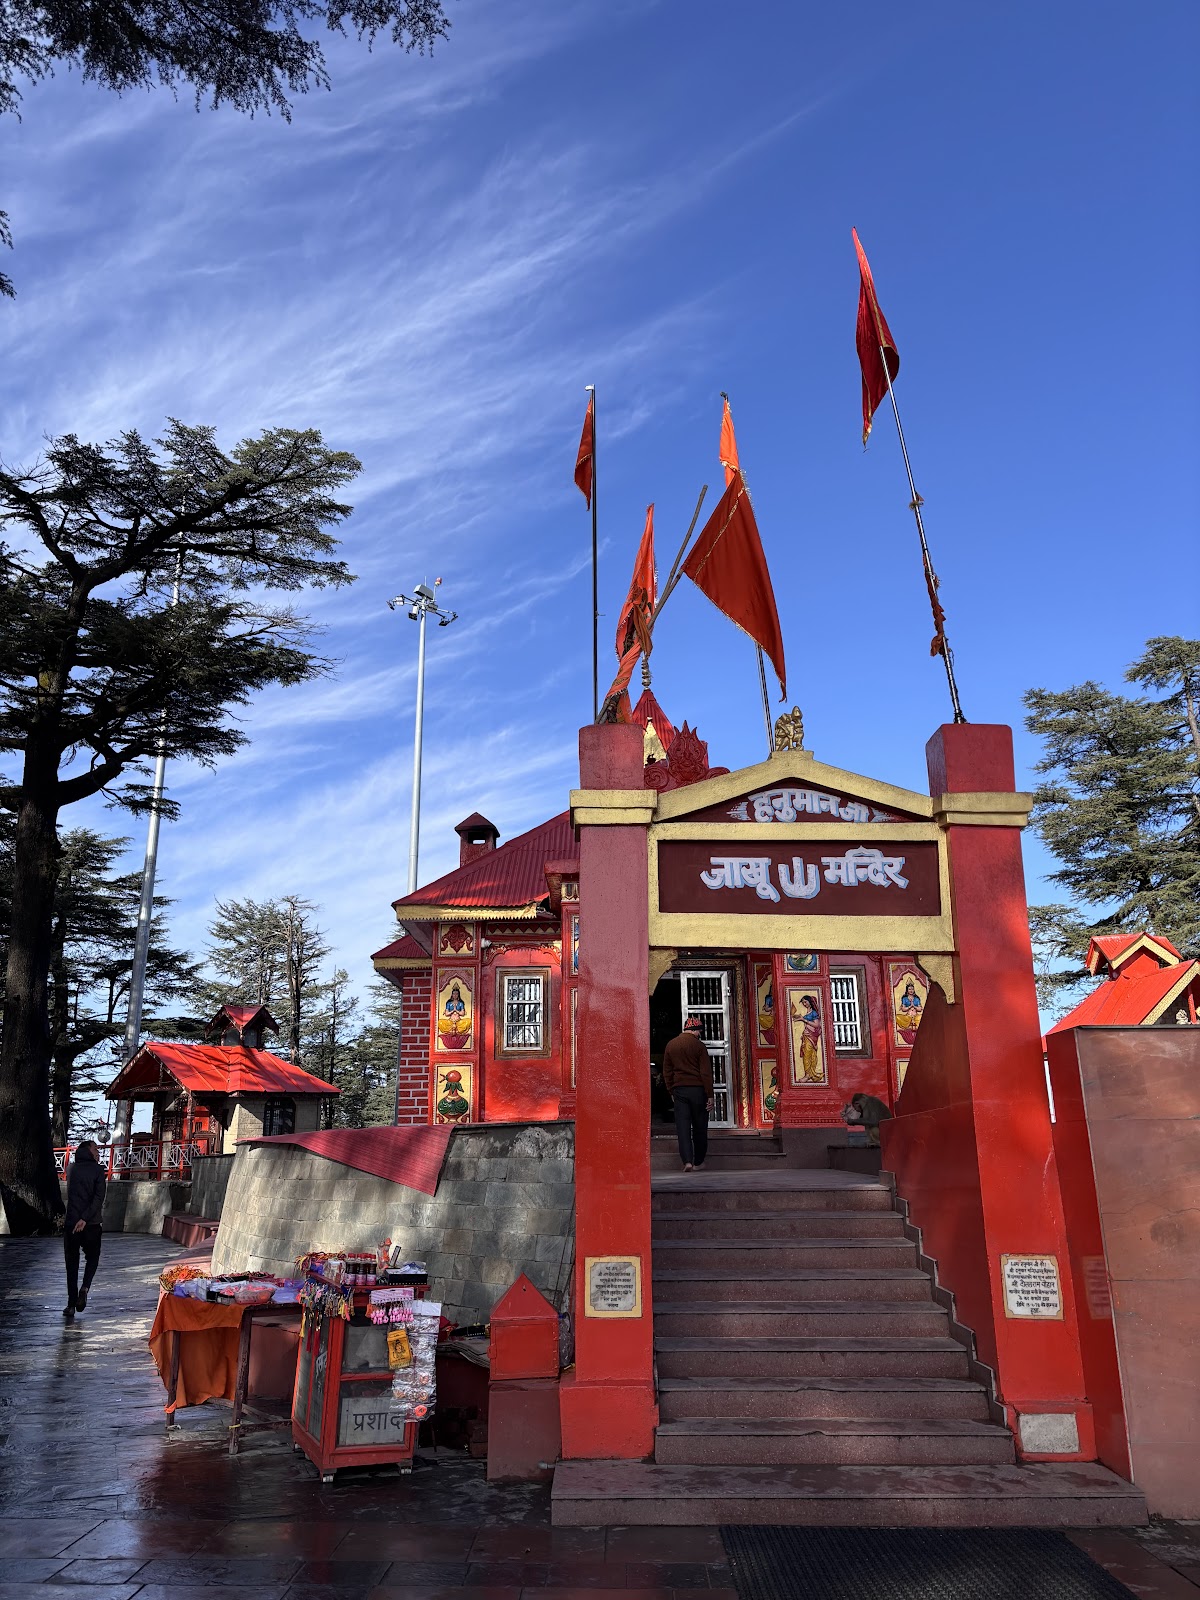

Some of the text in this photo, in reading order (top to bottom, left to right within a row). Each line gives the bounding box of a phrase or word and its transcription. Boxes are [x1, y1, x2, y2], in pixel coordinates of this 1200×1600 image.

[748, 788, 840, 822] हनुमान
[700, 845, 909, 903] जाखू मन्दिर
[353, 1412, 402, 1431] प्रशाद
